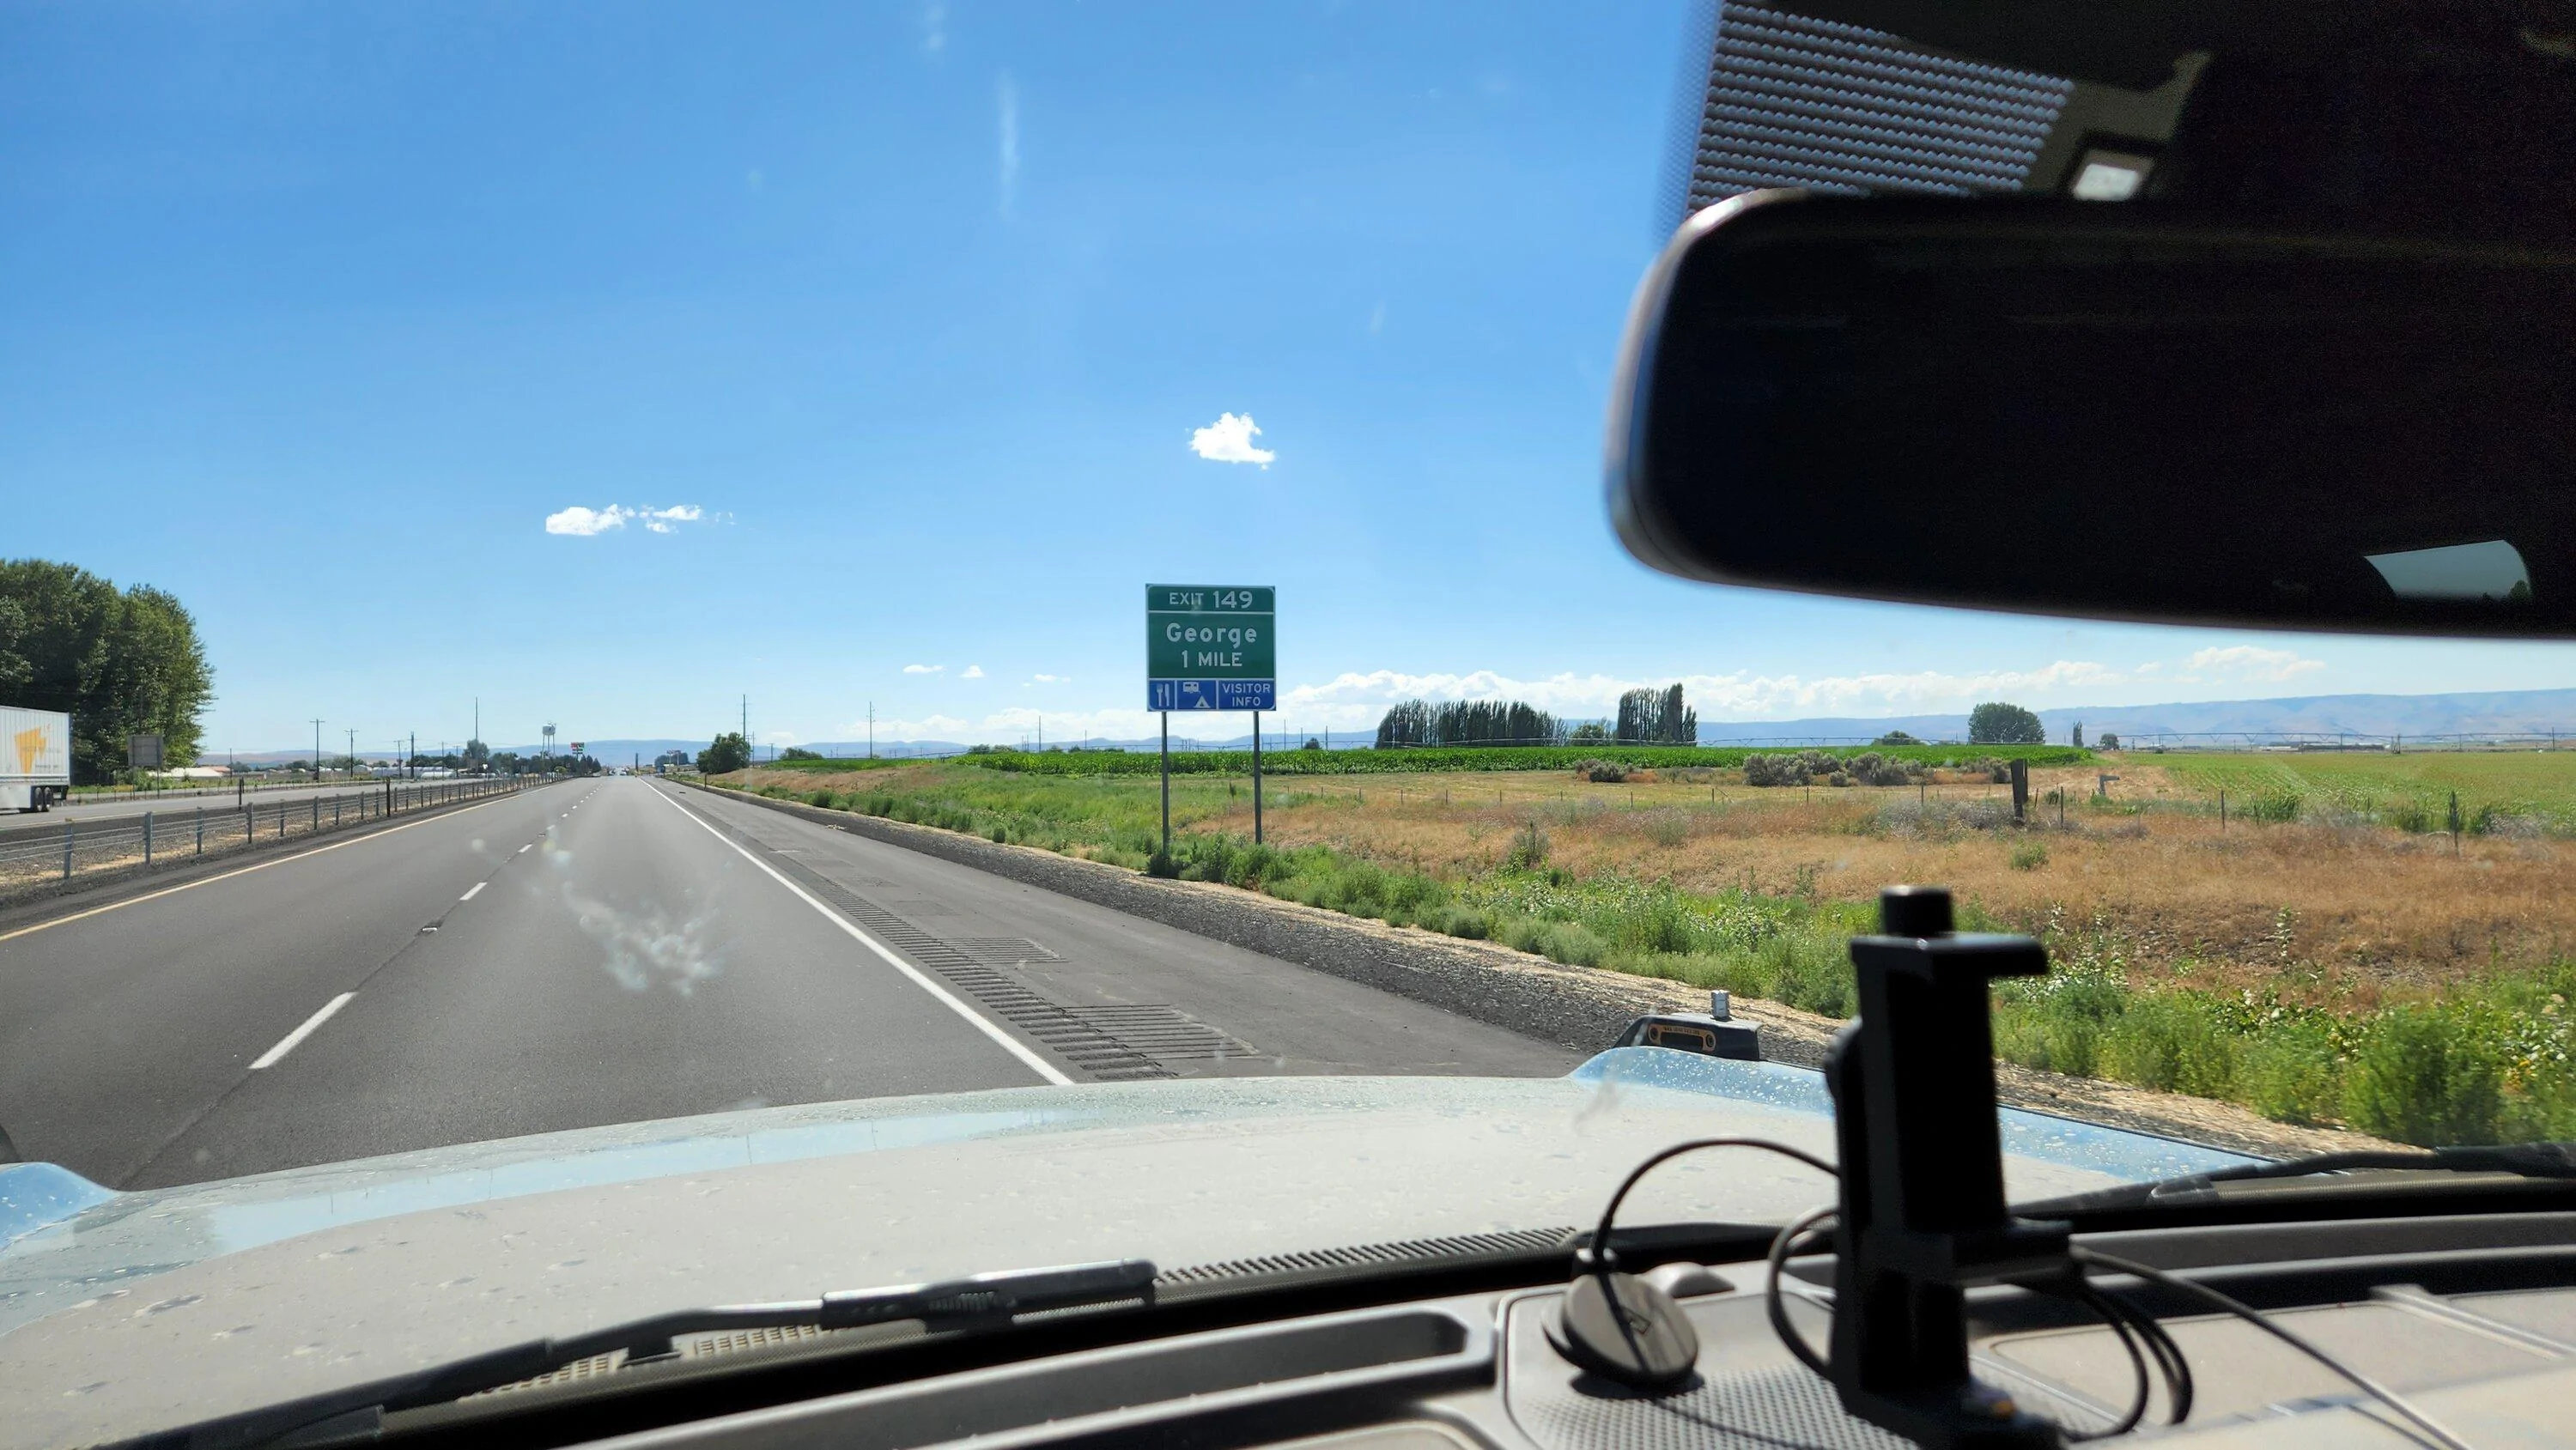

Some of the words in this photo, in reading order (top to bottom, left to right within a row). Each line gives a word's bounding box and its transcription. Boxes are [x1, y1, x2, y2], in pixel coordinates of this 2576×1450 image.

[1169, 592, 1204, 605] EXIT
[1212, 591, 1253, 608] 149
[1166, 622, 1257, 648] George
[1181, 650, 1188, 668] 1
[1198, 652, 1242, 667] MILE
[1222, 683, 1271, 694] VISITOR
[1231, 696, 1261, 707] INFO
